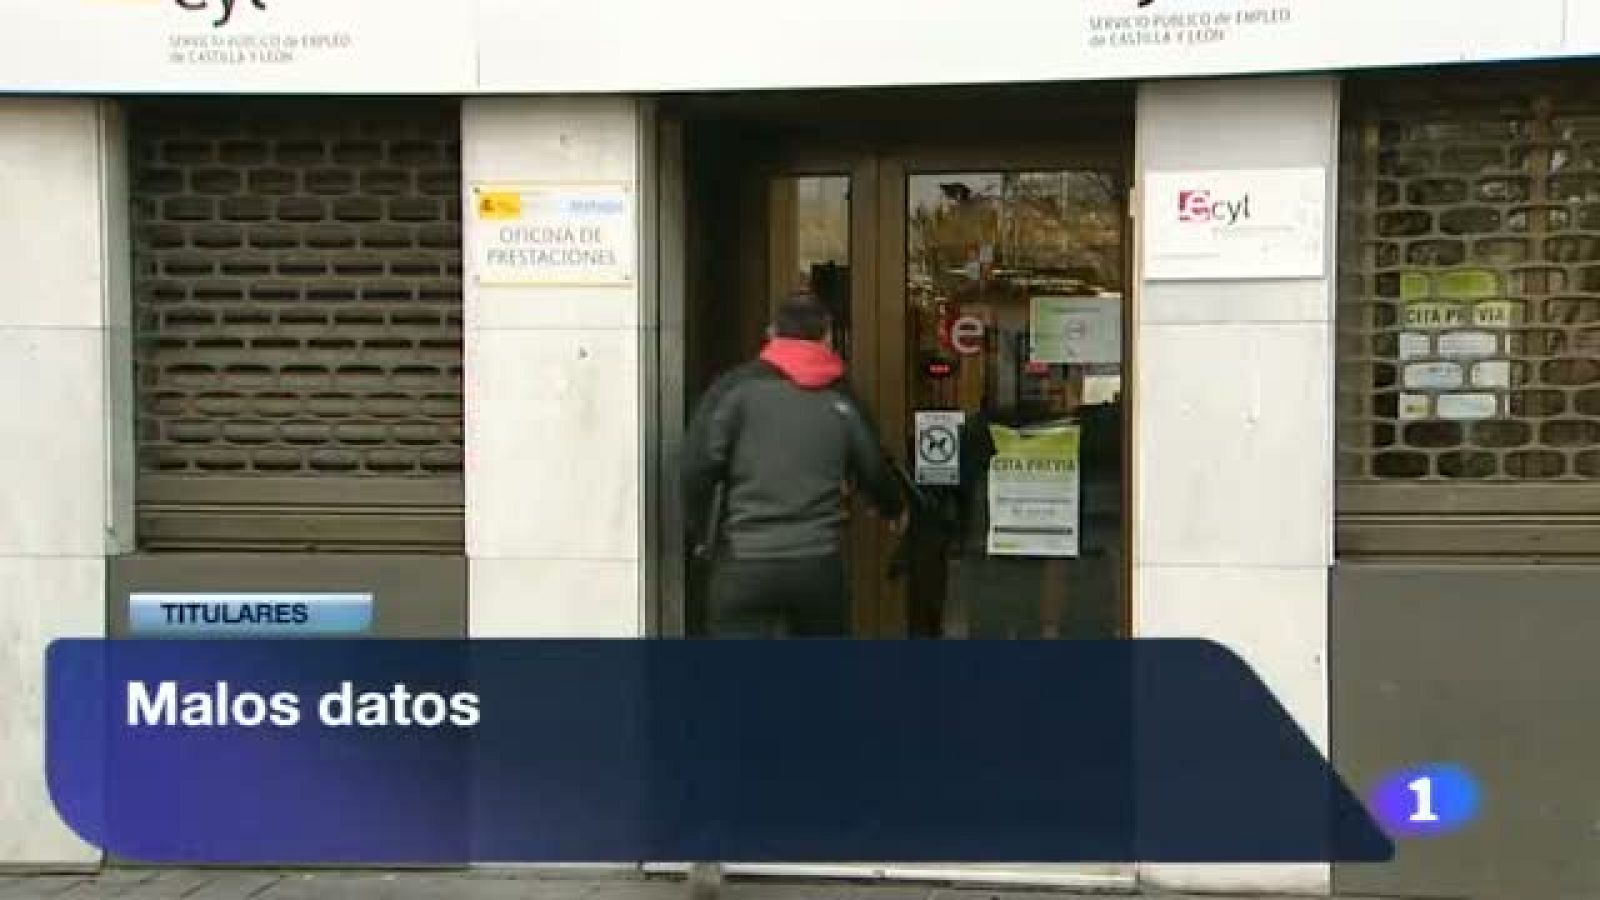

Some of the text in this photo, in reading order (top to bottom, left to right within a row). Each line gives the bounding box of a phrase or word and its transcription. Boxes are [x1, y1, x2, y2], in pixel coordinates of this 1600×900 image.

[1235, 8, 1291, 25] EMPLEO
[1109, 30, 1170, 47] CASTILLA
[189, 50, 246, 64] CASTILLA
[499, 226, 602, 244] OFICINA DE
[487, 249, 617, 266] PRESTACIONES
[993, 457, 1076, 473] CITA PREVIA
